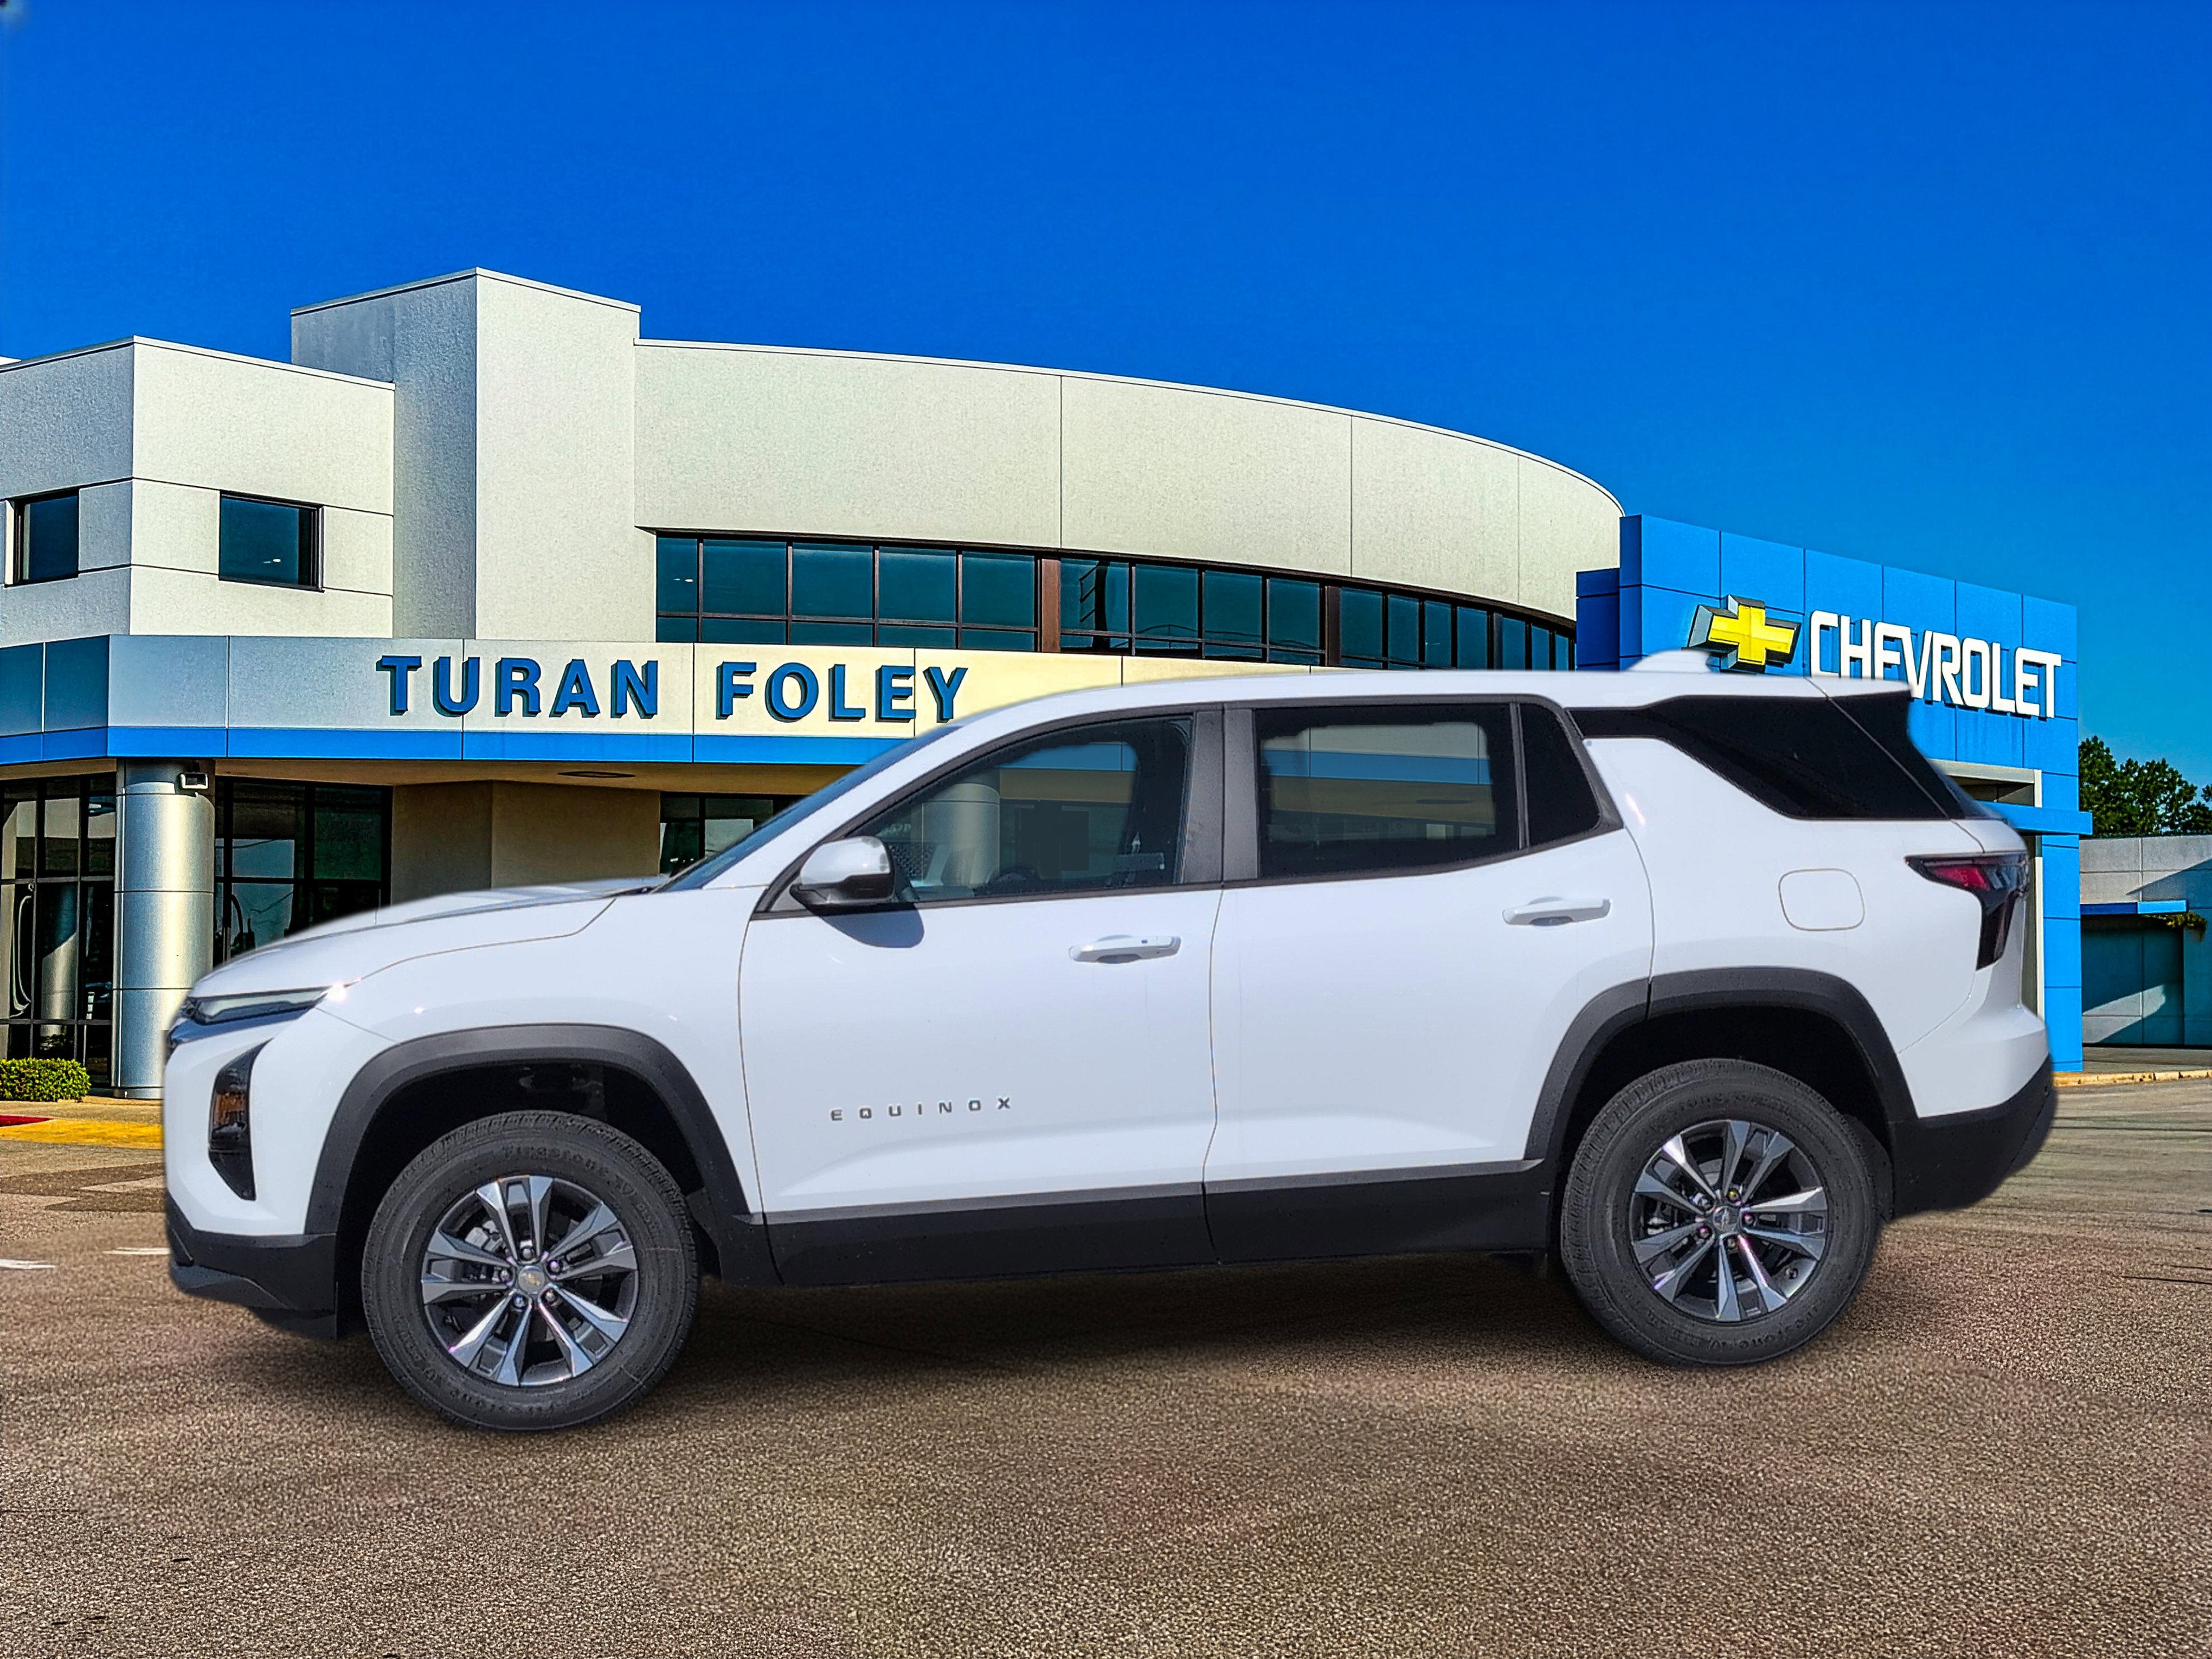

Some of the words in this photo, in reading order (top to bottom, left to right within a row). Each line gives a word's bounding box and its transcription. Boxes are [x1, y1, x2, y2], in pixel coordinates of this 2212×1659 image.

[376, 655, 658, 719] TURAN
[716, 661, 969, 723] FOLEY
[1810, 610, 2062, 718] CHEVROLET
[830, 1097, 1011, 1121] EQUINOX
